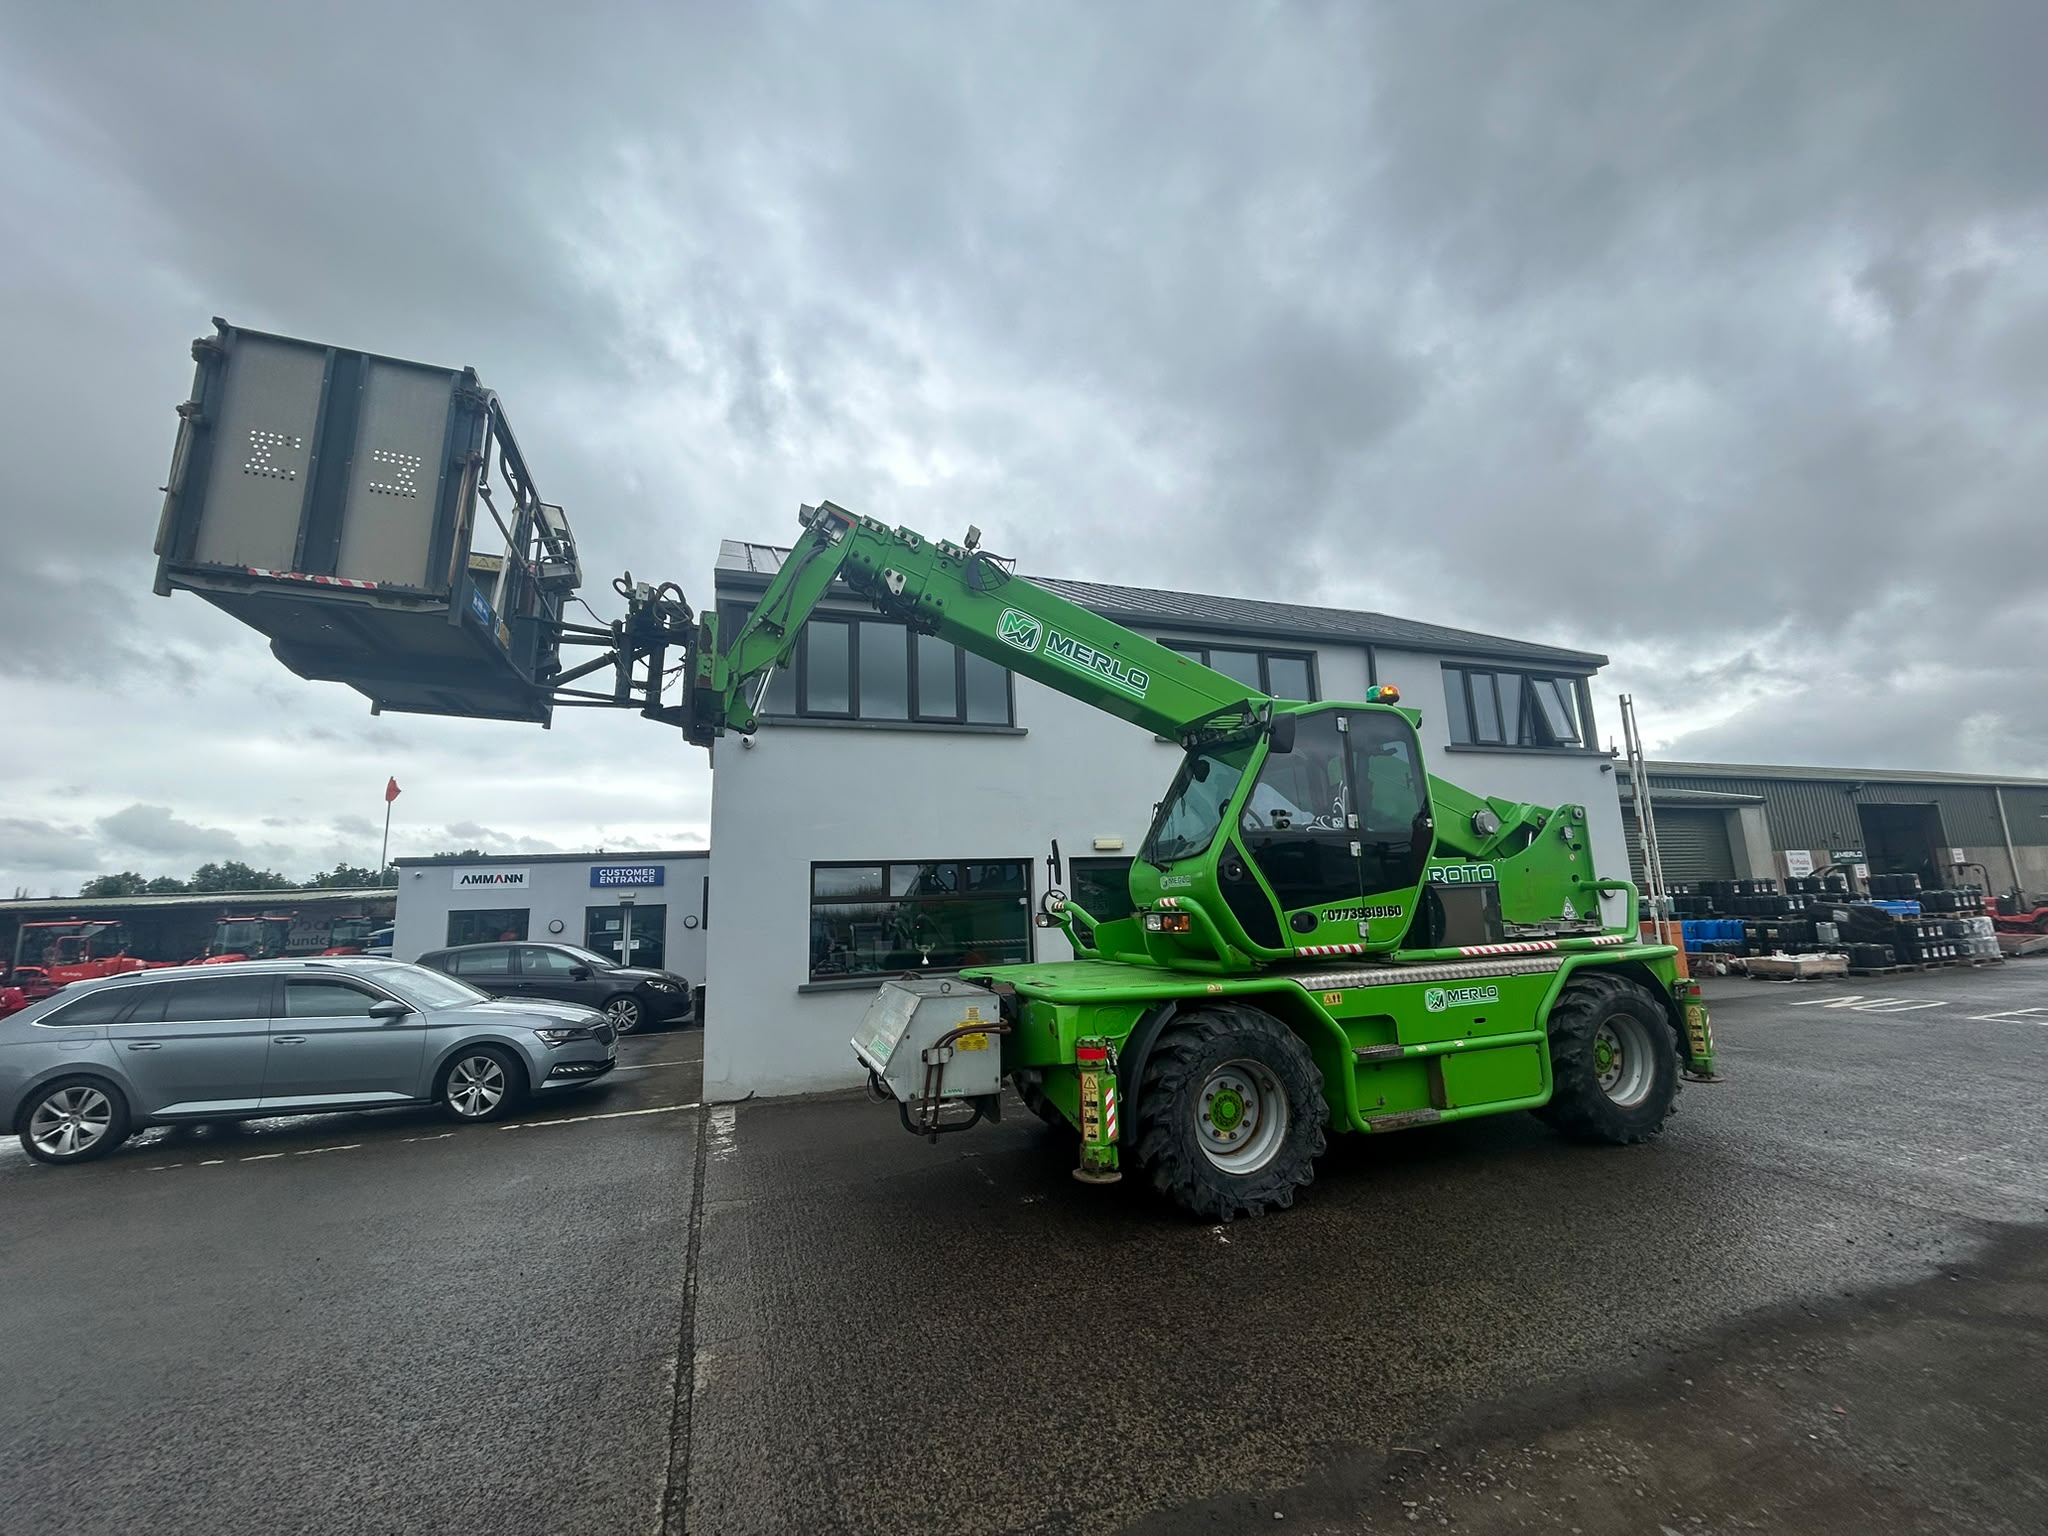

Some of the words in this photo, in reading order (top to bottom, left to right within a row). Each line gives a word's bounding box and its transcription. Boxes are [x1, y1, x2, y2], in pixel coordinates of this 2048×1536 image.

[1048, 630, 1149, 691] MERLO
[460, 874, 523, 884] AMMANN
[599, 868, 656, 877] CUSTOMER
[599, 875, 655, 884] ENTRANCE
[1428, 864, 1495, 883] ROTO
[1447, 985, 1498, 1002] MERLO
[1789, 995, 1949, 1012] NO
